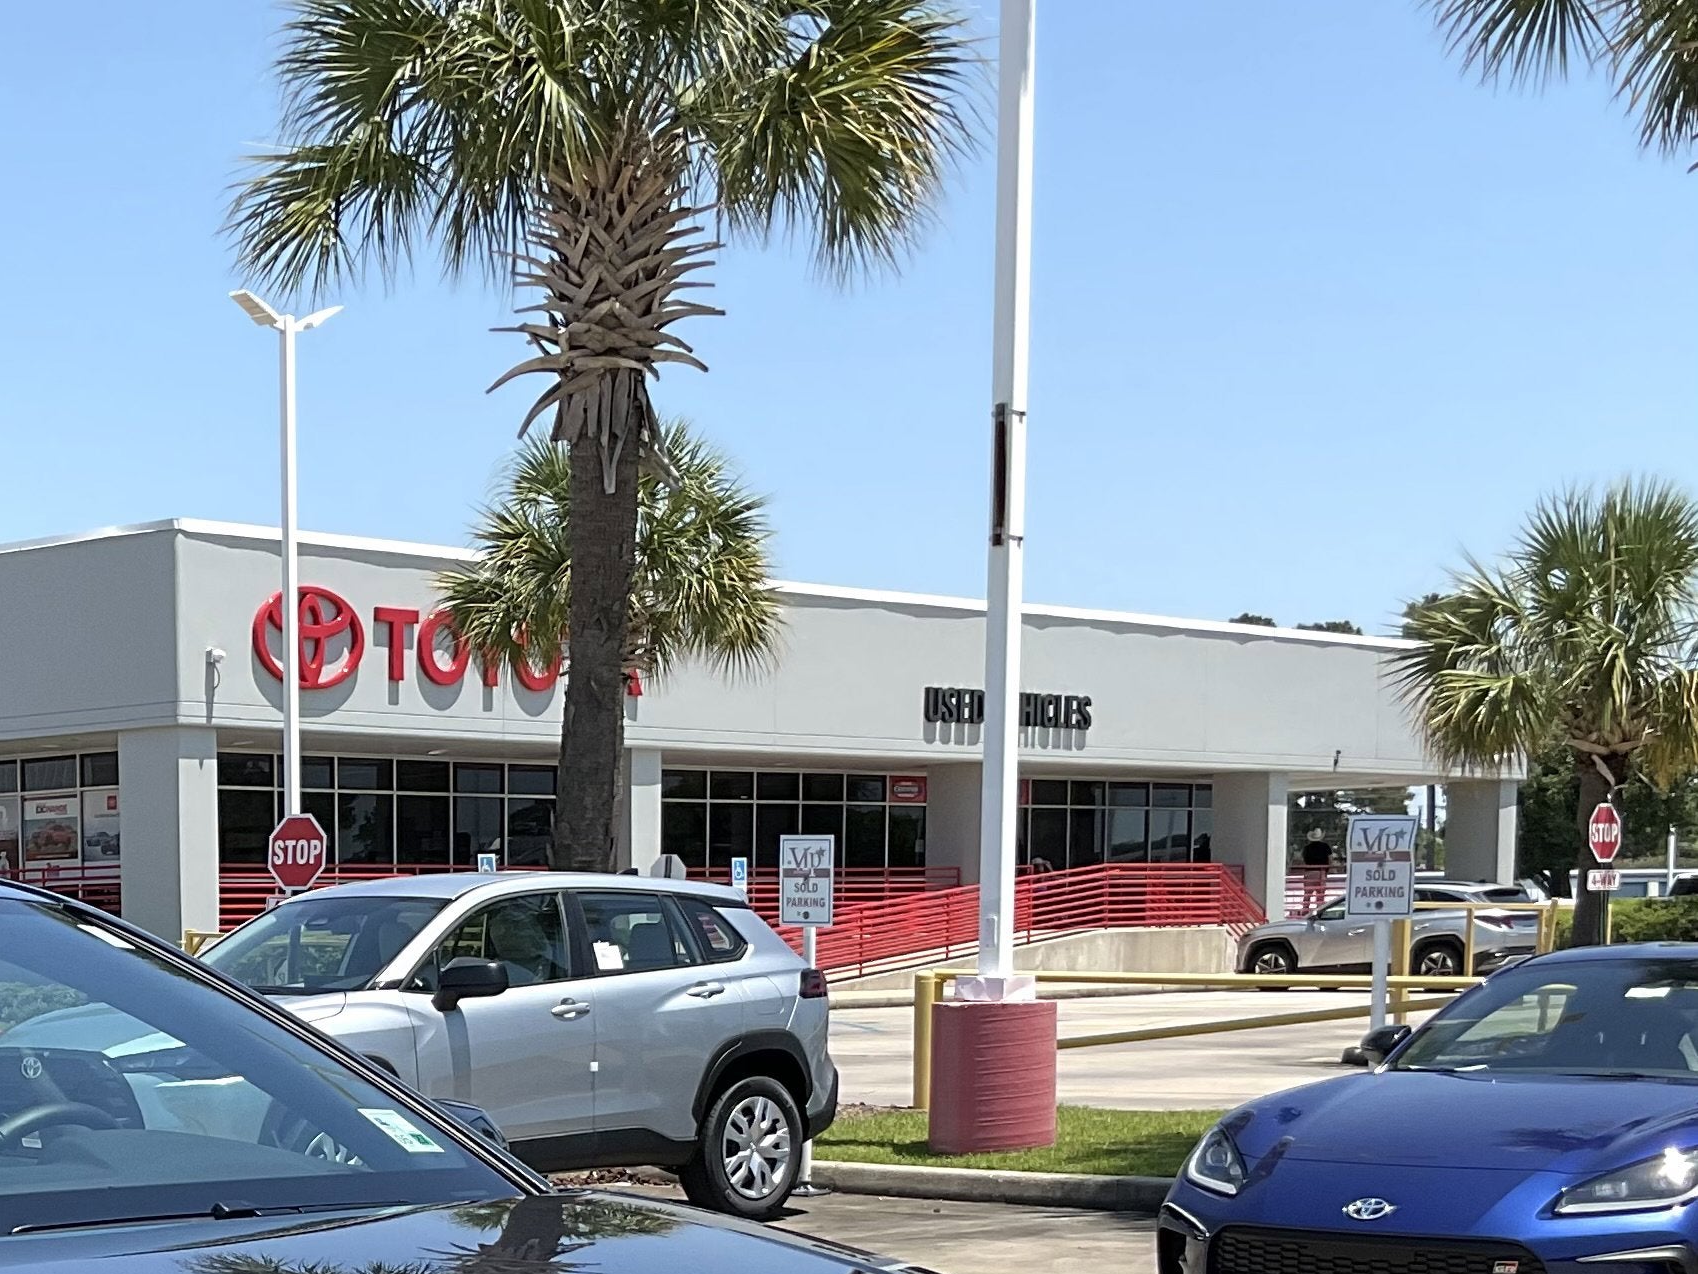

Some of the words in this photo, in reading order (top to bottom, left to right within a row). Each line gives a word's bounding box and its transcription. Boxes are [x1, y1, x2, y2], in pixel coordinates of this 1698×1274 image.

[924, 686, 985, 724] USED
[1019, 692, 1092, 731] HICLES
[1591, 822, 1618, 843] STOP
[273, 839, 322, 865] STOP
[1365, 870, 1396, 881] SOLD
[794, 882, 819, 893] SOLD
[1355, 886, 1405, 898] PARKING
[786, 897, 826, 908] PARKING
